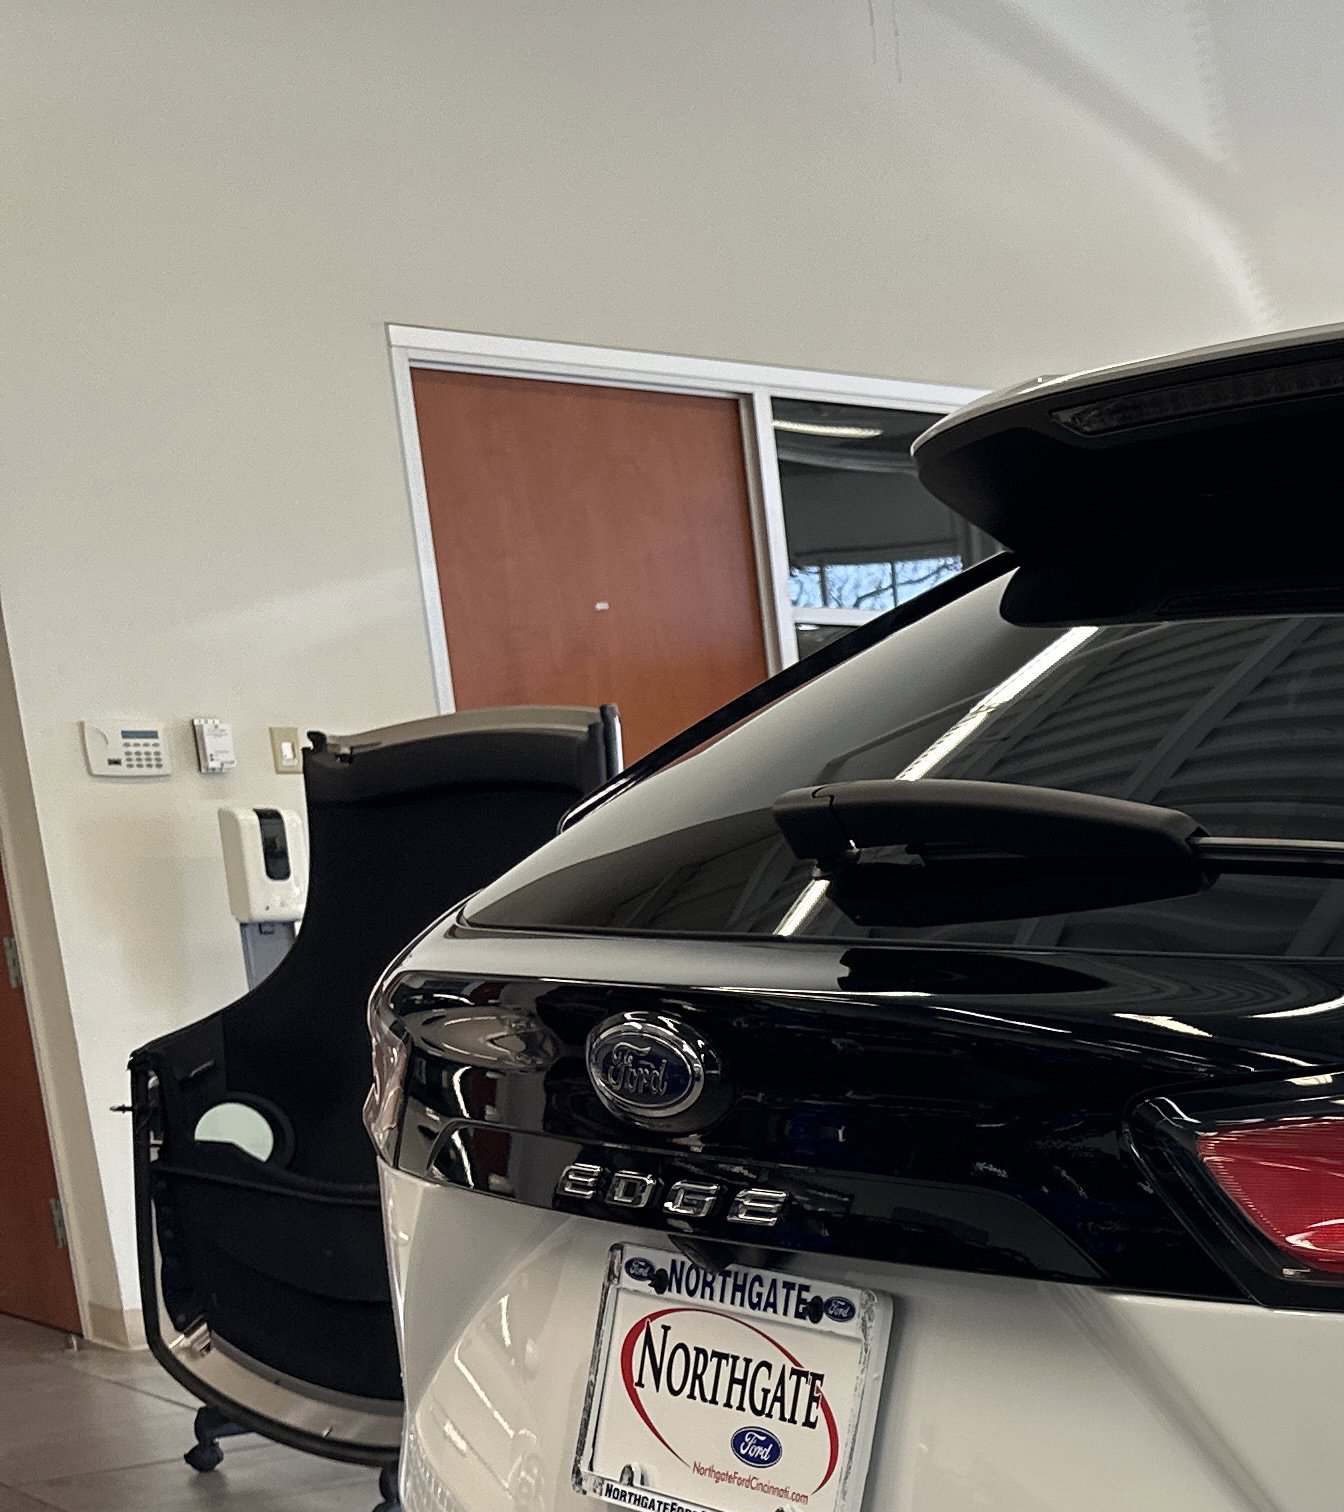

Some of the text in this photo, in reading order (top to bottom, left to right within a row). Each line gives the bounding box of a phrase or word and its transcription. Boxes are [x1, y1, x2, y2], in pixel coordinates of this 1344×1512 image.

[607, 1041, 669, 1096] Ford
[556, 1162, 790, 1227] EDGE
[666, 1258, 812, 1321] NORTHGATE
[827, 1300, 852, 1319] Ford
[634, 1320, 825, 1429] NORTHGATE
[740, 1432, 774, 1463] Ford
[692, 1460, 810, 1506] NorthgateFordCincinnati.com
